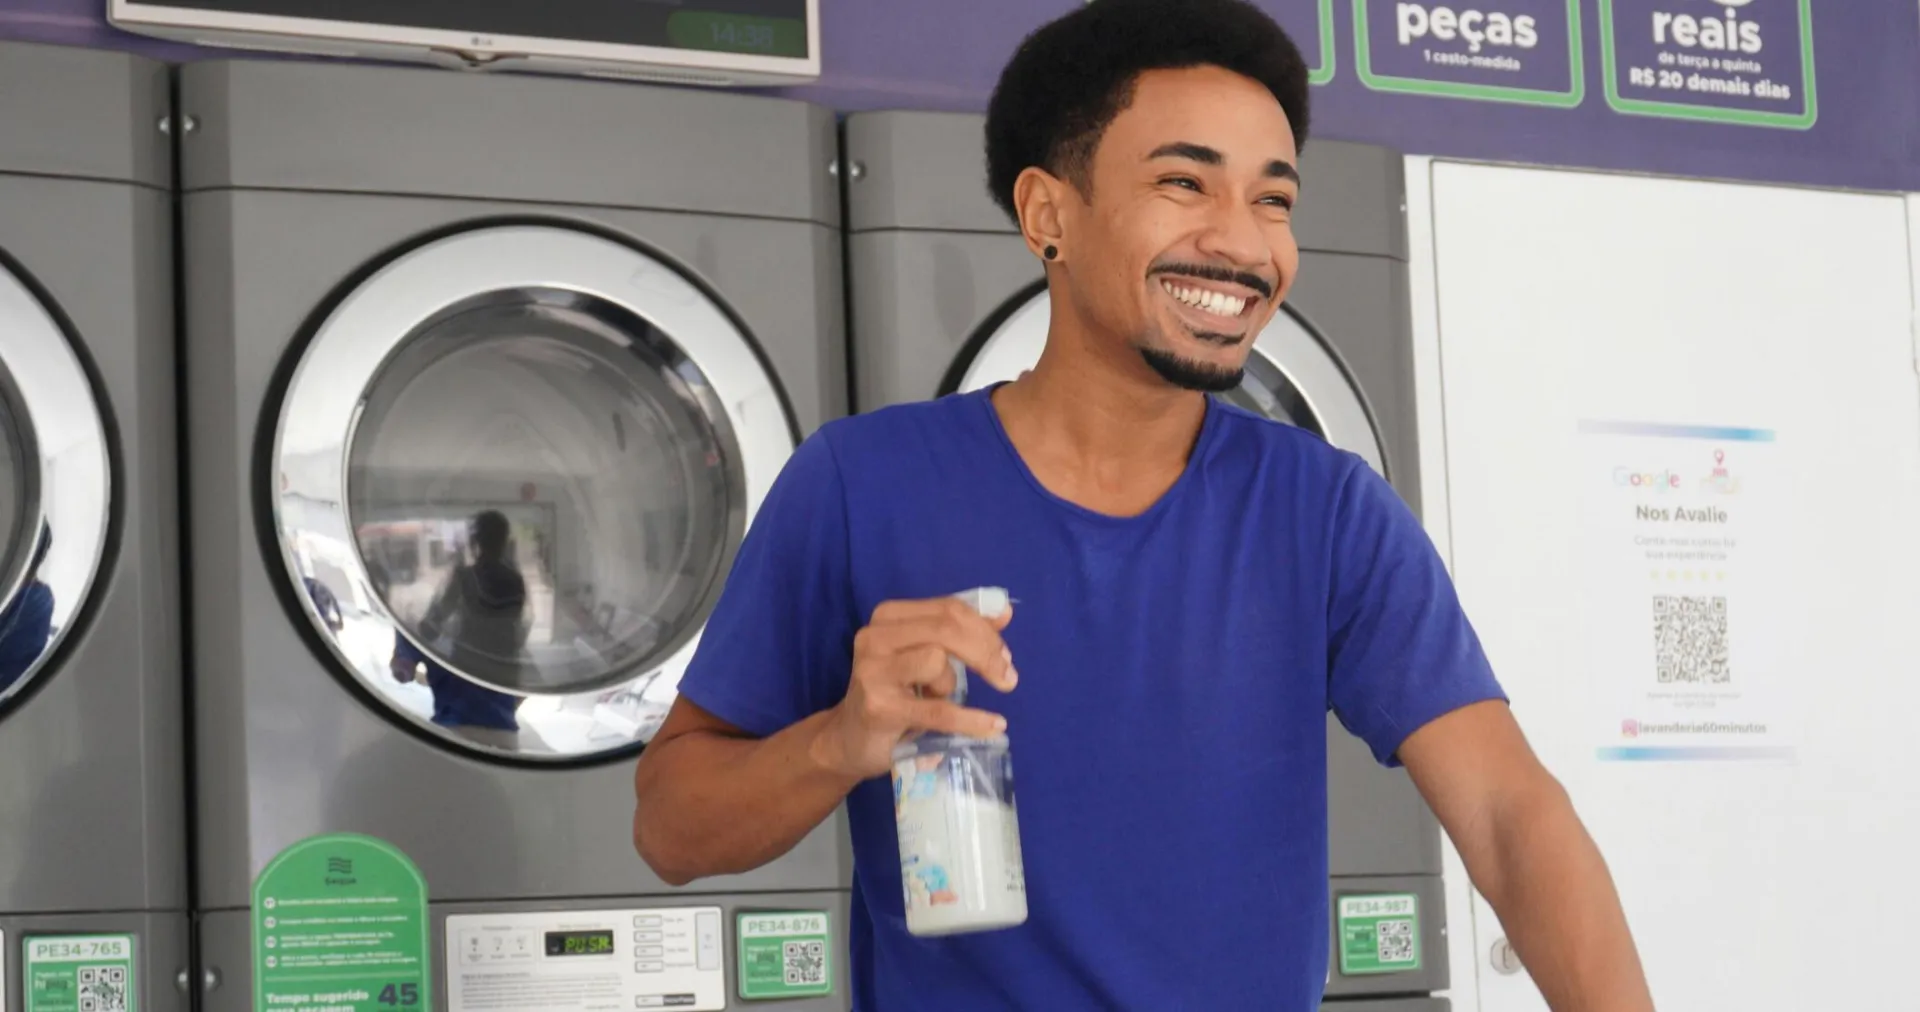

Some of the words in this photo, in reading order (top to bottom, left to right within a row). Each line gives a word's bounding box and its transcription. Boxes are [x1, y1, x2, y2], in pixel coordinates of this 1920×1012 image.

[1397, 2, 1538, 53] peças
[1652, 6, 1763, 54] reais
[1658, 51, 1676, 65] de
[1677, 53, 1710, 70] terça
[1712, 58, 1720, 69] a
[1721, 58, 1762, 73] quinta
[1629, 67, 1656, 87] R$
[1659, 69, 1684, 89] 20
[1687, 72, 1750, 96] demais
[1753, 79, 1791, 100] dias
[1613, 465, 1681, 494] Google
[1636, 504, 1670, 521] Nos
[1674, 505, 1728, 524] Avalie
[1638, 721, 1767, 735] lavanderia60minutos
[748, 918, 820, 933] PE34-876
[37, 941, 122, 958] PE34-765
[265, 992, 310, 1005] Tempo
[312, 989, 370, 1004] sugerido
[378, 982, 419, 1007] 45
